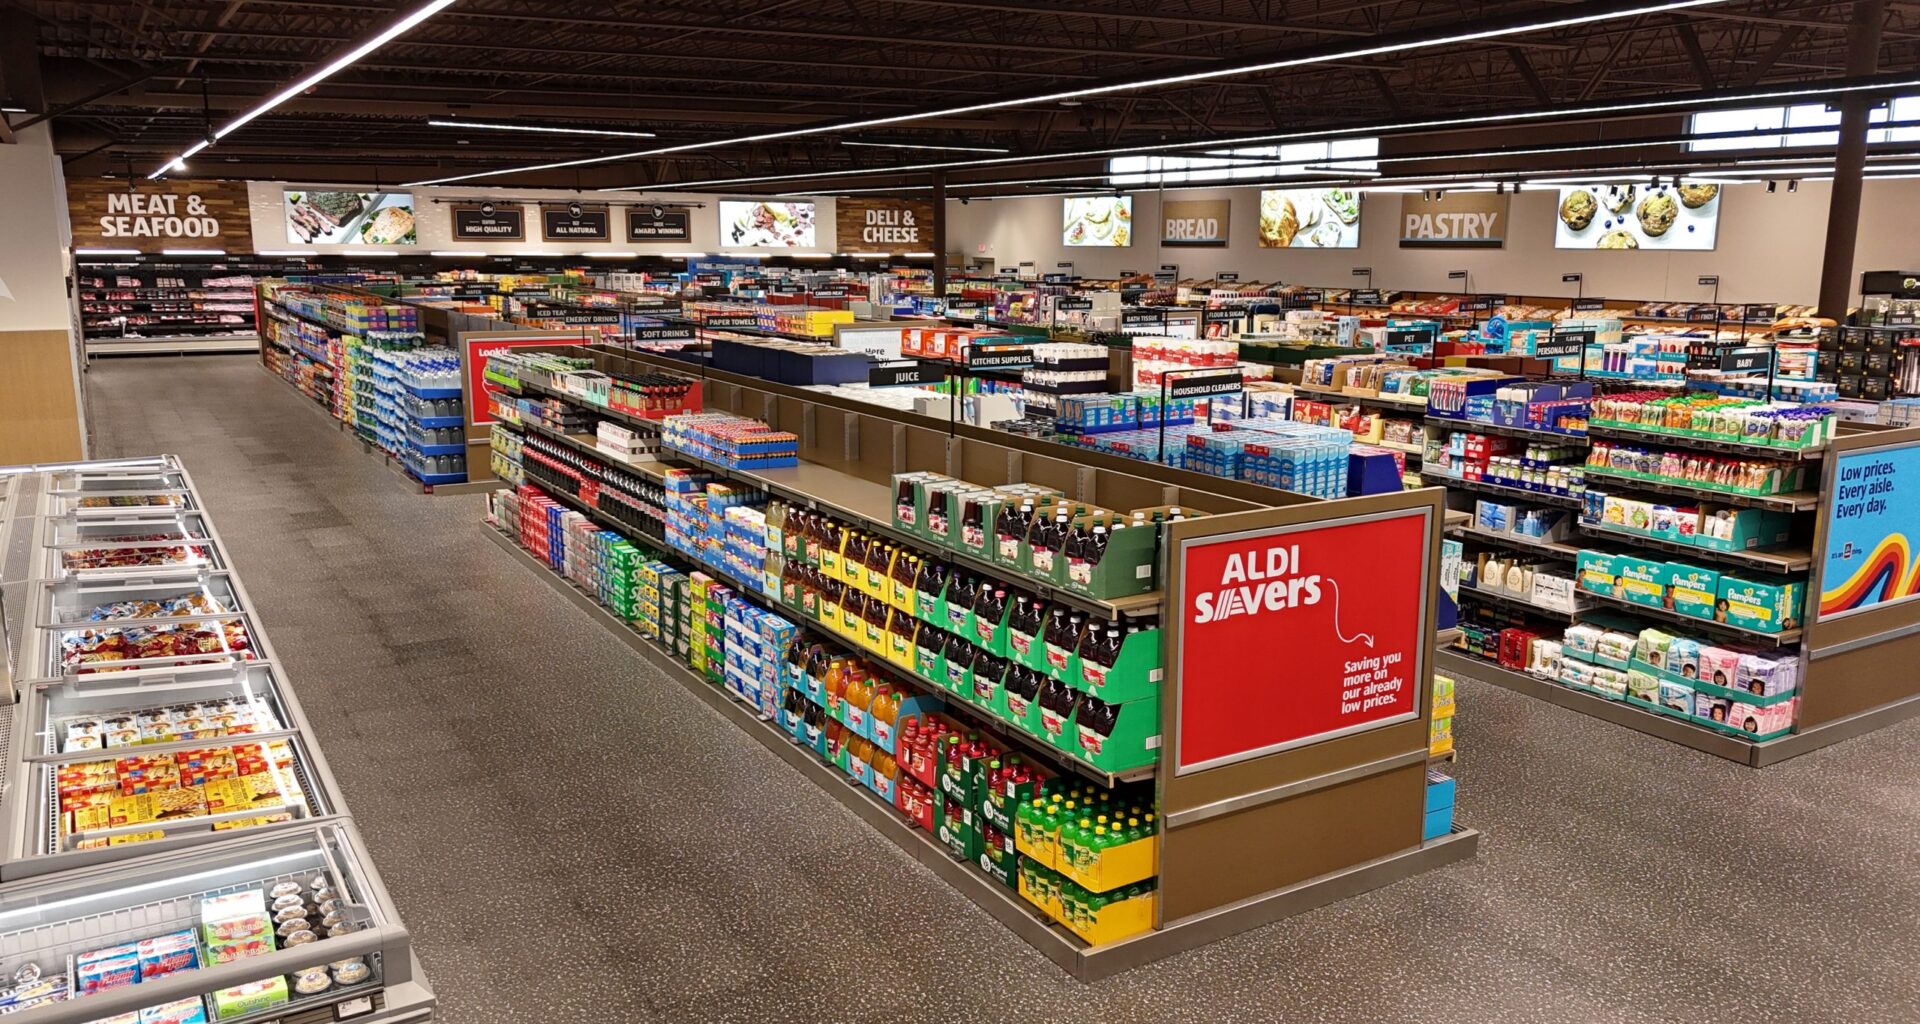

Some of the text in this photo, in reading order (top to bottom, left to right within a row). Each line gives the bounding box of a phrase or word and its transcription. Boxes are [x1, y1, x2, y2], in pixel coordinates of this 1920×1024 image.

[108, 194, 208, 215] MEAT &
[866, 210, 915, 226] DELI &
[1405, 212, 1498, 239] PASTRY
[100, 216, 220, 238] SEAFOOD
[484, 226, 513, 234] QUALITY
[863, 227, 919, 243] CHEESE
[1165, 218, 1218, 240] BREAD
[593, 315, 618, 323] DRINKS
[709, 318, 755, 326] PAPER TOWELS
[662, 330, 689, 338] DRINKS
[1404, 335, 1415, 343] PET
[1537, 346, 1579, 355] PERSONAL CARE
[972, 355, 1031, 365] KITCHEN SUPPLIES
[1736, 359, 1753, 368] BABY
[895, 371, 919, 384] JUICE
[1173, 383, 1241, 395] HOUSEHOLD CLEANERS
[1841, 460, 1896, 482] Low prices.
[1838, 478, 1894, 500] Every aisle.
[1836, 497, 1887, 519] Every day.
[1221, 545, 1299, 585] ALDI
[1584, 560, 1608, 573] Pampers
[1623, 566, 1653, 582] Pampers
[1672, 573, 1706, 591] Pampers
[1727, 588, 1761, 605] Pampers
[1344, 652, 1401, 674] Saving you
[1343, 669, 1388, 687] more on
[1342, 677, 1402, 700] our already
[1342, 693, 1397, 714] low prices.
